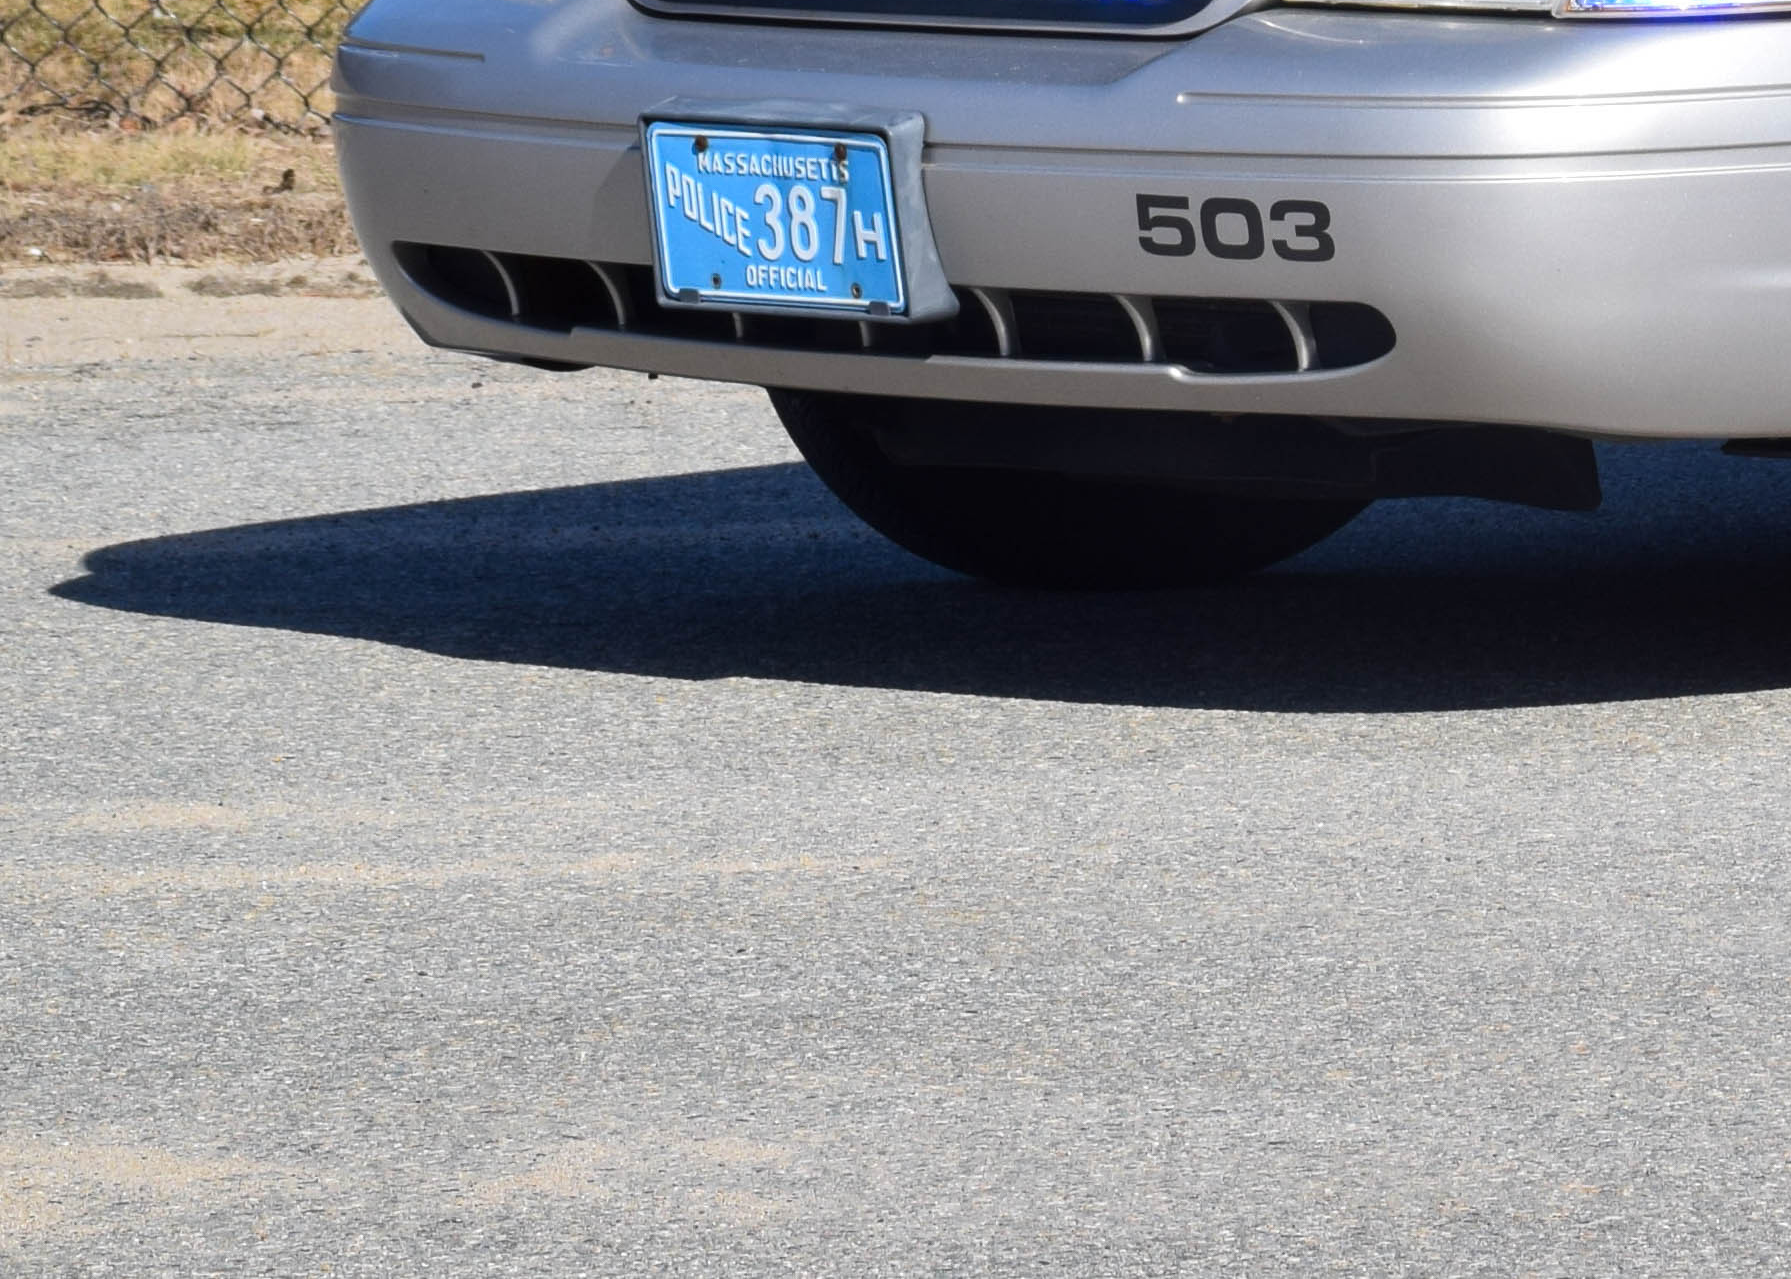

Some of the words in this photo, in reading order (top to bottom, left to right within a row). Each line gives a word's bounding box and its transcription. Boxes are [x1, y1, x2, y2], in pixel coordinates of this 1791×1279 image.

[697, 150, 850, 183] MASSACHUSETTS
[664, 161, 753, 258] POLICE
[1136, 193, 1336, 263] 503
[746, 264, 828, 293] OFFICIAL
